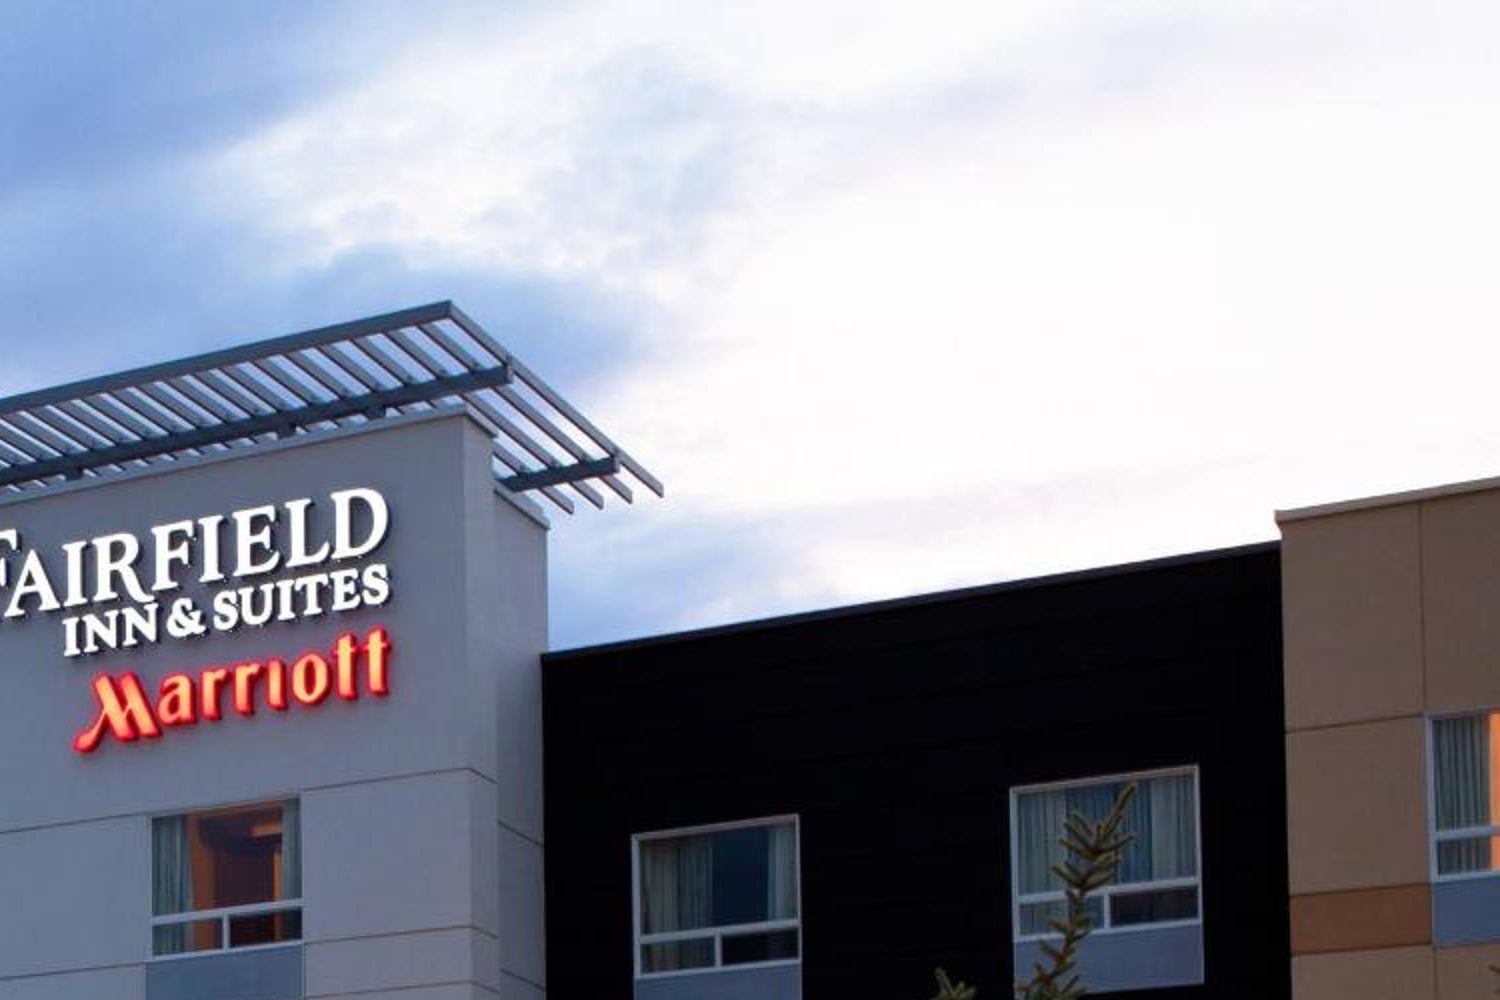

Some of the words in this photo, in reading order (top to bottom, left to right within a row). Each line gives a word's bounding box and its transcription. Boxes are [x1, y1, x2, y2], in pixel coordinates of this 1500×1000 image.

[63, 602, 159, 657] INN
[165, 597, 206, 638] &
[214, 563, 391, 631] SUITES
[72, 623, 393, 753] Marriott
